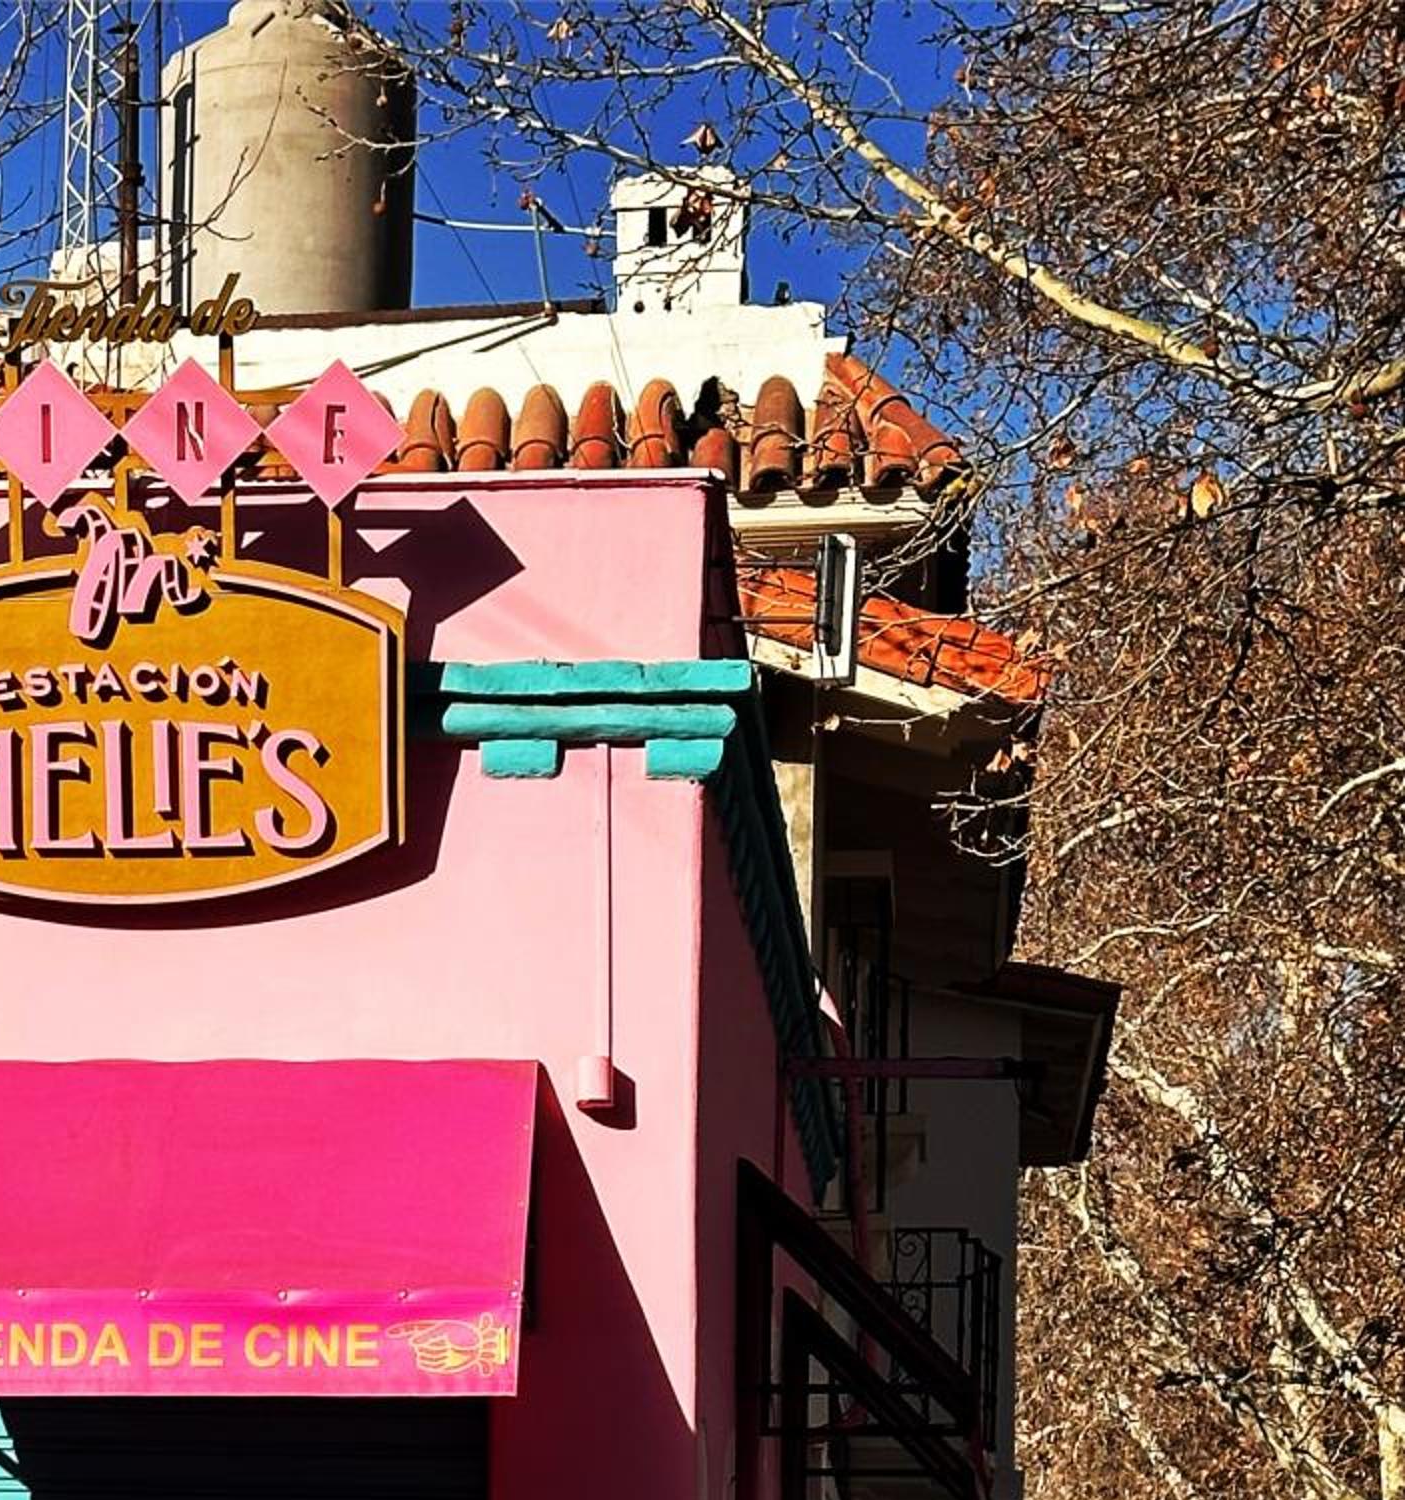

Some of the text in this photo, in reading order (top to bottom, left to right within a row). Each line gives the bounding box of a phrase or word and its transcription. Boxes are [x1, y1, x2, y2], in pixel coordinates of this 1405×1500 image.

[191, 272, 258, 336] de
[148, 1323, 224, 1367] DE
[244, 1323, 380, 1367] CINE
